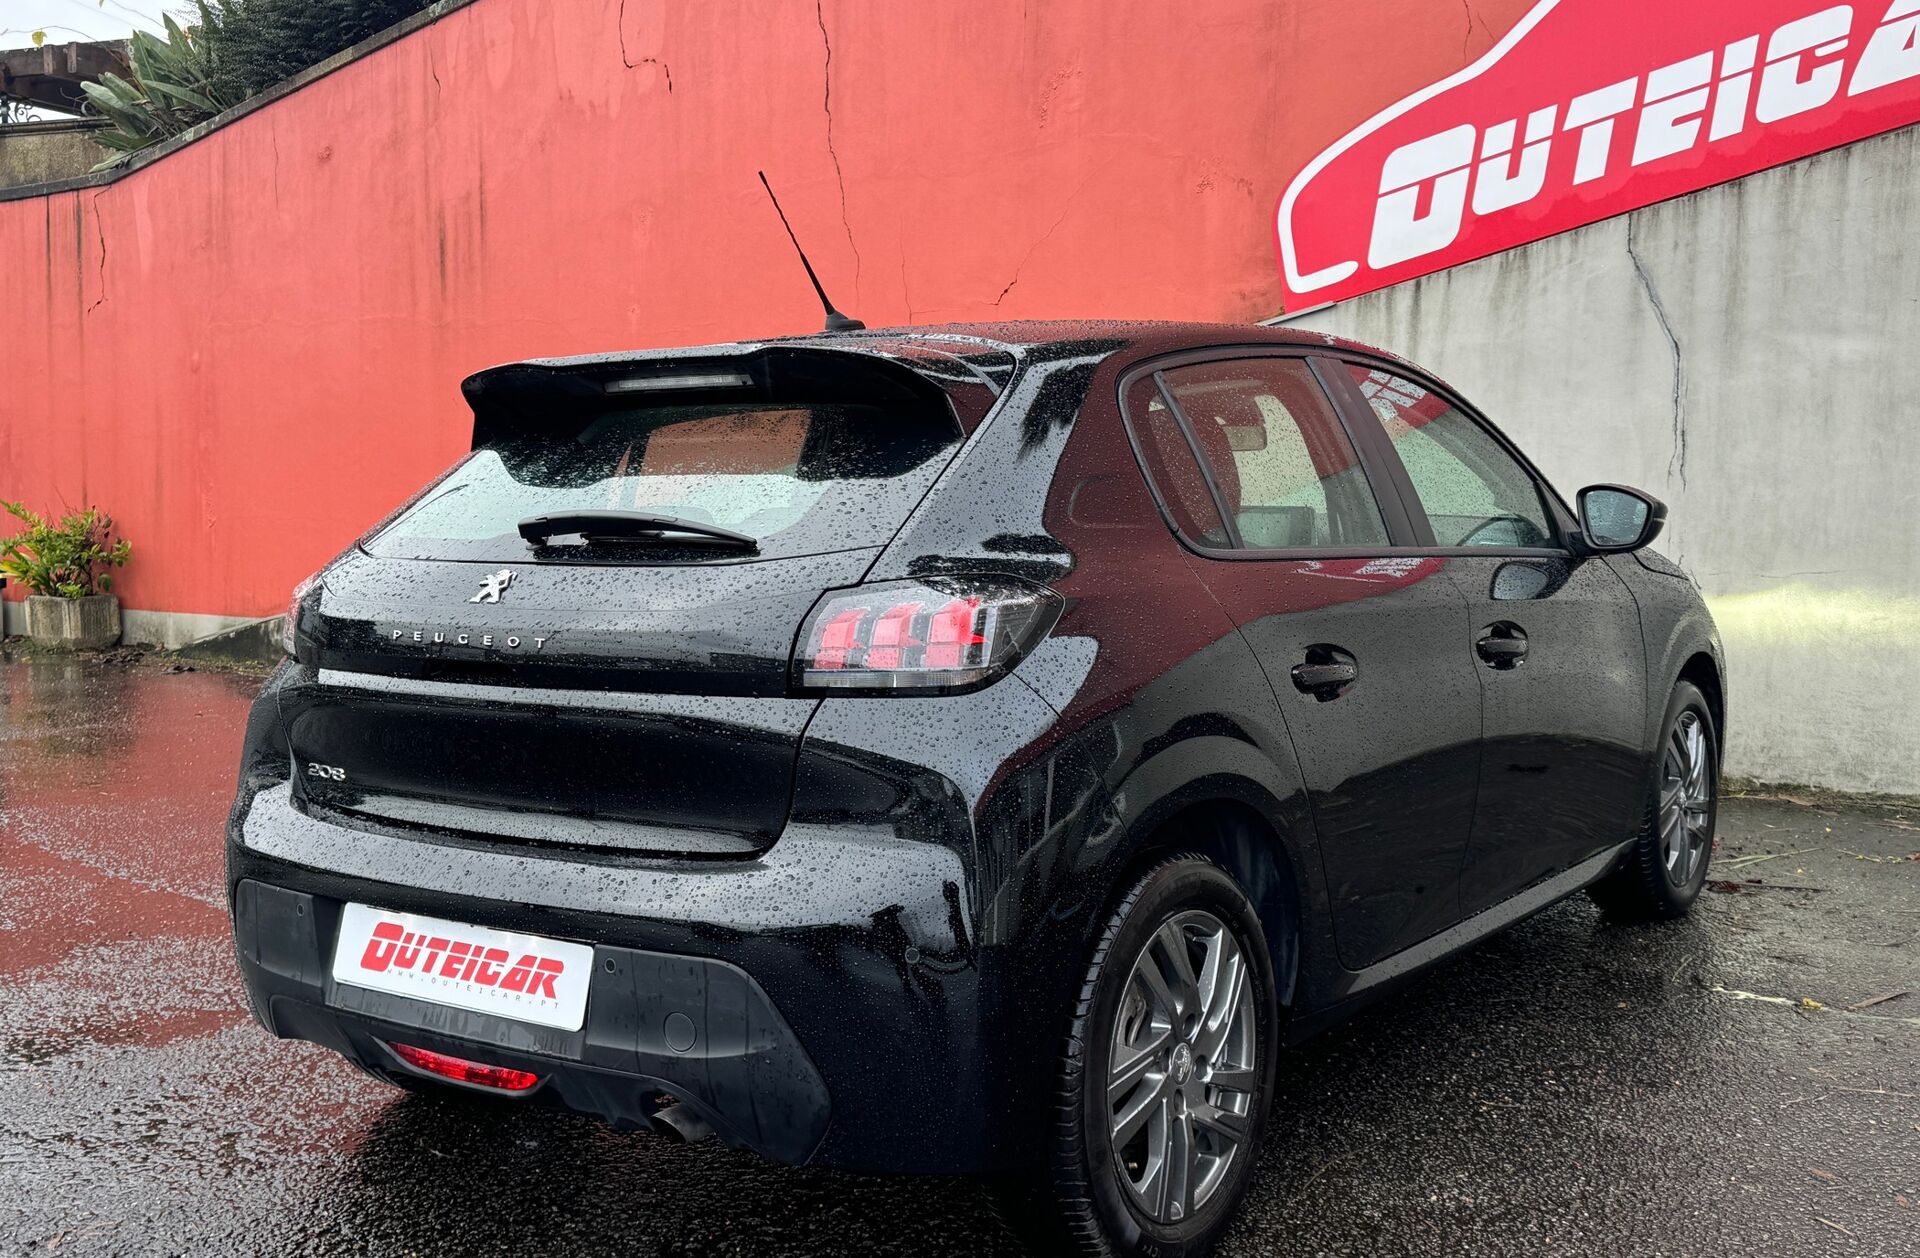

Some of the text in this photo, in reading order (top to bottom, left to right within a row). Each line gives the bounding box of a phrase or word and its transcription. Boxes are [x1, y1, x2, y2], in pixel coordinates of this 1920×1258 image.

[393, 629, 546, 649] PEUGEOT
[307, 762, 346, 781] 208
[360, 921, 565, 999] OUTEICAR
[386, 969, 559, 1009] WWW.OUTEICAR.PT
